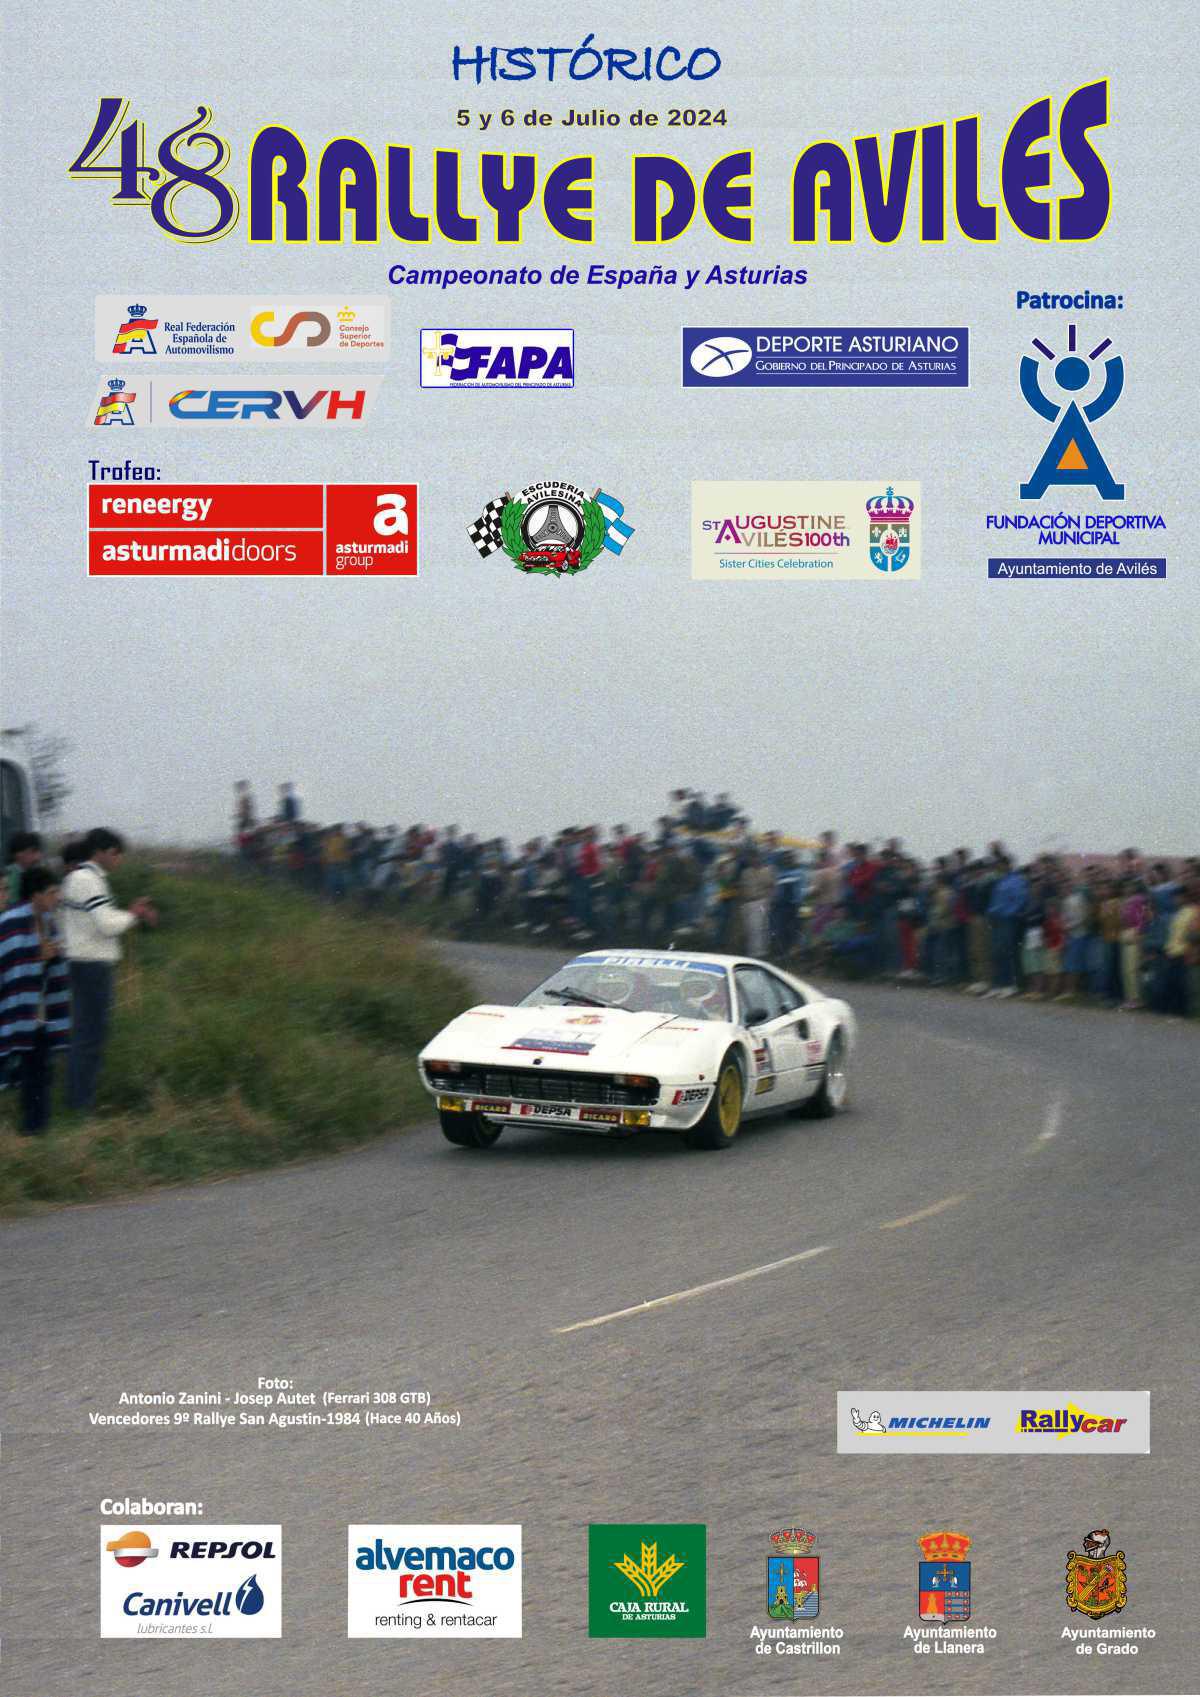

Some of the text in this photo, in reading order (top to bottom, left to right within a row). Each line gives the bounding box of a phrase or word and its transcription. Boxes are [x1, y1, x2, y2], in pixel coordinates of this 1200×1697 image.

[452, 33, 721, 84] HISTÓRICO
[456, 109, 727, 130] 5 y 6 de Julio de 2024
[69, 77, 1112, 245] 48 RALLYE DE AVILES
[388, 264, 807, 289] Campeonato de España y Asturias
[1016, 290, 1124, 310] Patrocina:
[164, 321, 235, 333] Real Federación
[339, 324, 369, 333] Consejo
[173, 333, 227, 345] Española de
[339, 332, 371, 341] Superior
[351, 340, 384, 349] Deportes
[756, 335, 959, 353] DEPORTE ASTURIANO
[165, 345, 234, 356] Automovilismo
[469, 346, 573, 379] FAPA
[755, 360, 956, 371] GOBIERNO DEL PRINCIPADO DE ASTURIAS
[169, 390, 366, 420] CERVH
[88, 460, 161, 481] Trofeo:
[522, 481, 585, 498] ESCUDERIA
[527, 489, 582, 506] AVILESINA
[102, 497, 212, 521] reneergy
[986, 512, 1166, 529] FUNDACIÓN DEPORTIVA
[1038, 531, 1120, 545] MUNICIPAL
[336, 541, 409, 554] asturmadi
[336, 554, 373, 570] group
[719, 559, 833, 569] Sister Cities Celebration
[998, 562, 1157, 578] Ayuntamiento de Avilés
[258, 1377, 293, 1390] Foto:
[119, 1392, 175, 1405] Antonio
[178, 1392, 221, 1405] Zanini
[233, 1392, 273, 1407] Josep
[277, 1392, 316, 1405] Autet
[323, 1392, 369, 1406] (Ferrari
[373, 1392, 396, 1404] 308
[400, 1392, 431, 1406] GTB)
[89, 1412, 461, 1428] Vencedores 9º Rallye San Agustin-1984 (Hace 40 Años)
[888, 1417, 991, 1429] MICHELIN
[100, 1498, 203, 1516] Colaboran:
[170, 1541, 276, 1560] REPSOL
[356, 1539, 515, 1571] alvemaco
[399, 1570, 472, 1598] rent
[123, 1592, 232, 1616] Canivell
[609, 1601, 689, 1613] CAJA RURAL
[375, 1613, 498, 1629] renting & rentacar
[622, 1613, 676, 1621] DE ASTURIAS
[137, 1623, 198, 1634] lubricantes
[750, 1626, 844, 1642] Ayuntamiento
[903, 1625, 997, 1641] Ayuntamiento
[1061, 1626, 1156, 1641] Ayuntamiento
[755, 1641, 841, 1655] de Castrillon
[914, 1641, 985, 1654] de Llanera
[1076, 1642, 1139, 1655] de Grado
